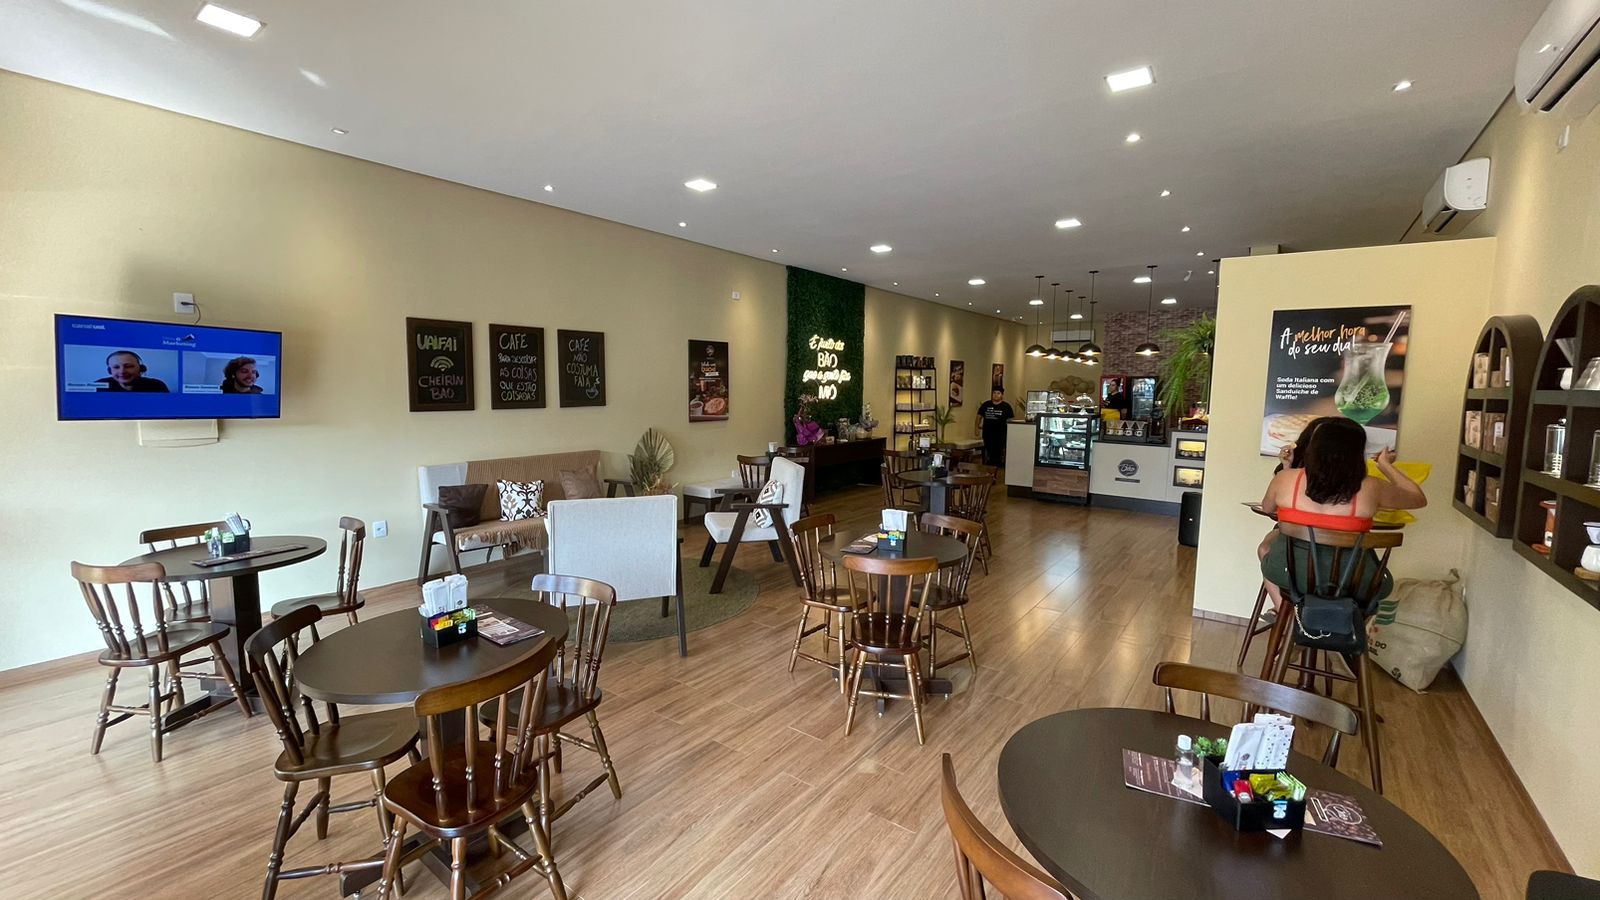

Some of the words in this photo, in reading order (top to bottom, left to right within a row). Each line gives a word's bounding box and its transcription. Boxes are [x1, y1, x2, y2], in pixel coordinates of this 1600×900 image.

[1280, 327, 1293, 349] A
[1294, 325, 1336, 344] melhor
[1340, 324, 1367, 340] hora
[1288, 341, 1301, 360] do
[1304, 341, 1330, 356] seu
[499, 366, 510, 378] AS
[566, 362, 599, 377] COSTUMA
[499, 380, 514, 391] QUE
